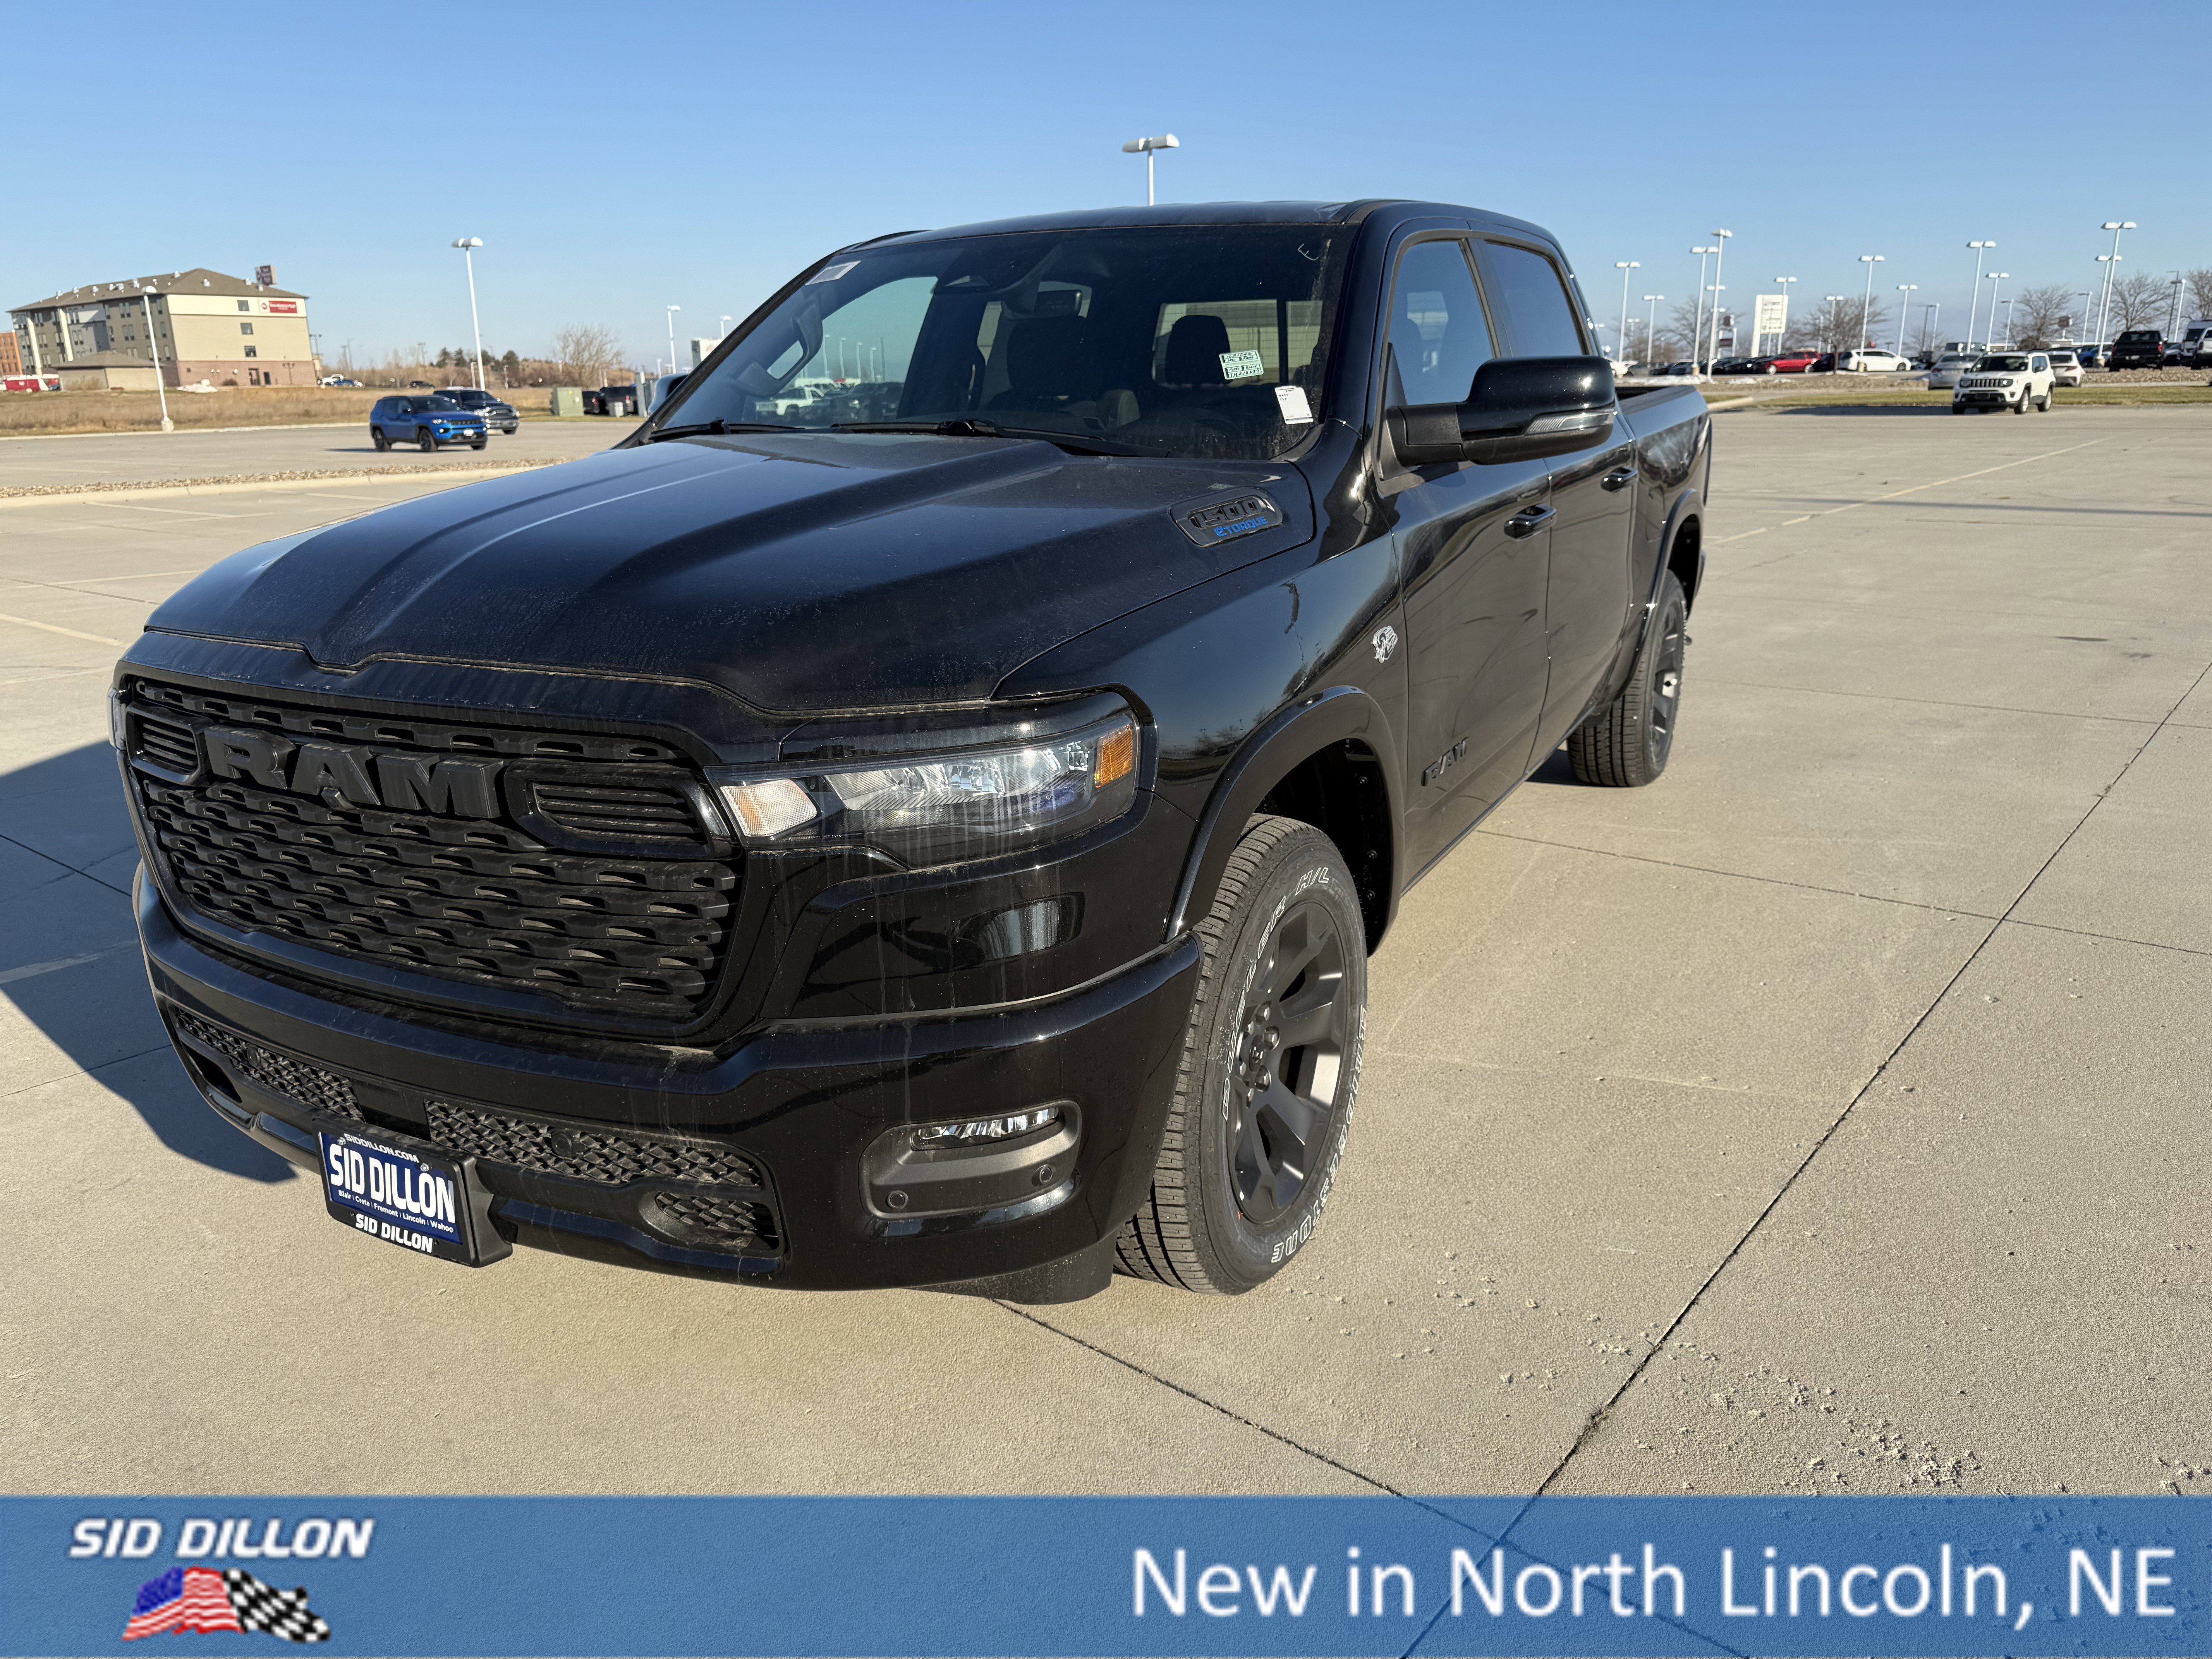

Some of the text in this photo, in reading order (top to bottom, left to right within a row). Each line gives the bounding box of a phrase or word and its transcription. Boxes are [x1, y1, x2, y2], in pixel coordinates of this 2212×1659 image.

[1189, 496, 1268, 529] 1500
[204, 725, 504, 818] RAM
[1421, 737, 1468, 787] RAM
[1295, 867, 1329, 895] H/L
[344, 1133, 420, 1163] SIDDILLON.COM
[1271, 1005, 1367, 1263] BRIDGESTONE
[330, 1144, 455, 1224] SID DILLON
[338, 1190, 454, 1233] Blair Crete Fremont Lincoln Wahoo
[356, 1213, 433, 1253] SID DILLON
